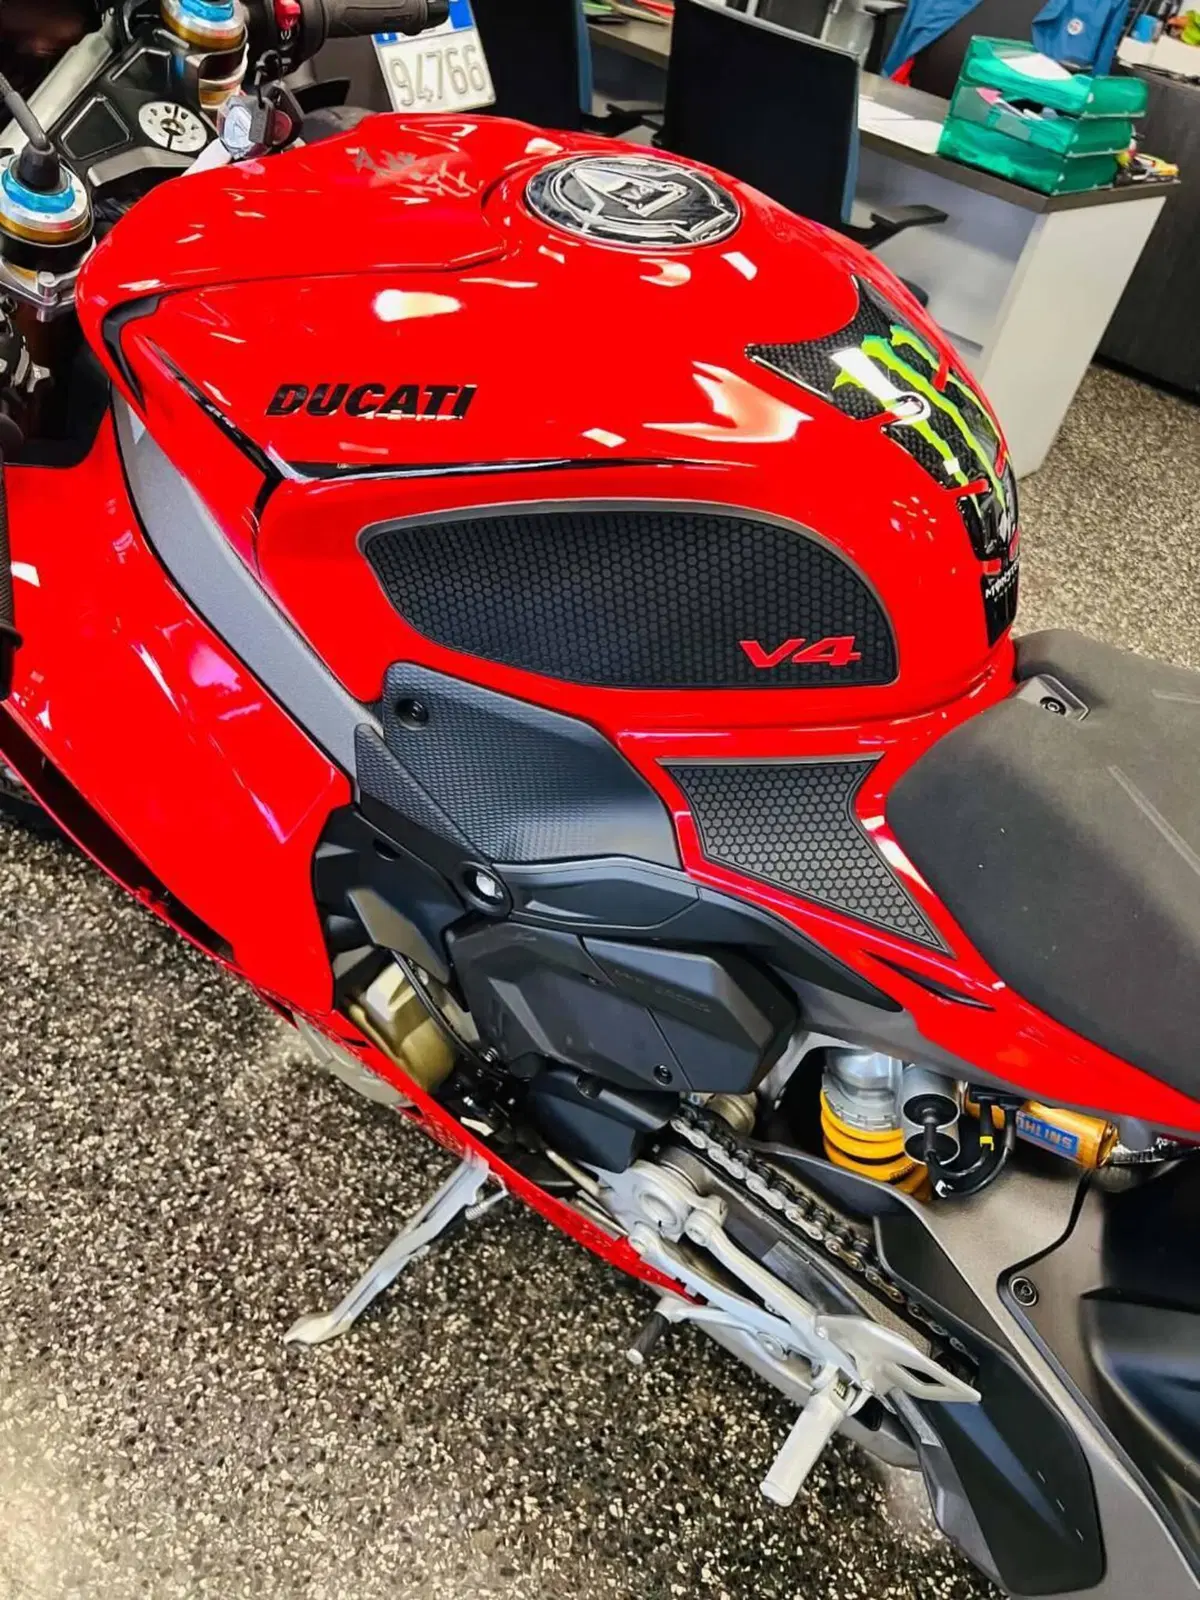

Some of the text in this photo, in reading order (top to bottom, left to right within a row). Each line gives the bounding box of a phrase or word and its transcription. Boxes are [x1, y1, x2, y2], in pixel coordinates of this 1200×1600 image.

[389, 44, 486, 106] 94766
[265, 383, 478, 420] DUCATI
[739, 635, 862, 668] V4
